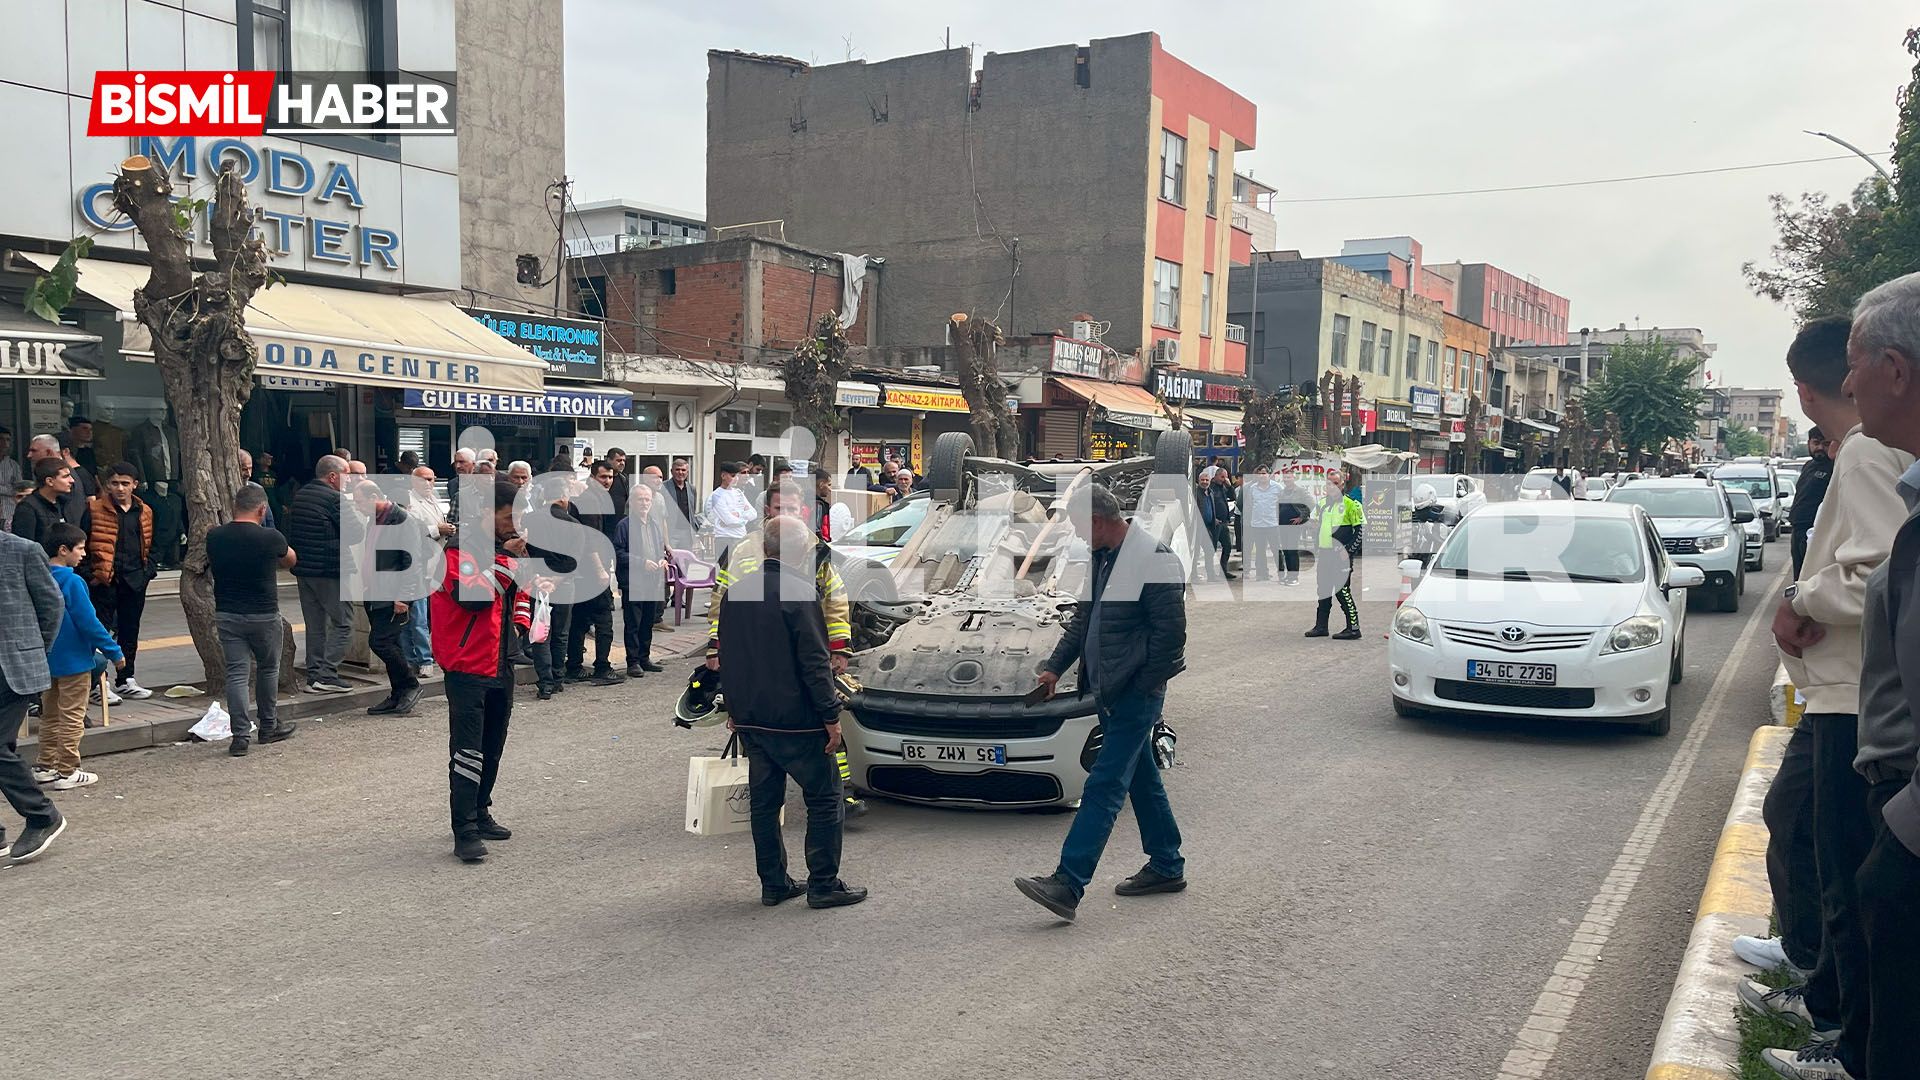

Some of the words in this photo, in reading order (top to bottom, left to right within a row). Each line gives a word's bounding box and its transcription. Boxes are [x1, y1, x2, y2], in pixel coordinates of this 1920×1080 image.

[137, 136, 366, 208] MODA
[79, 181, 400, 270] CTER
[520, 322, 600, 347] ELEKTRONİK
[265, 343, 338, 370] ODA
[358, 352, 480, 384] CENTER
[1084, 346, 1102, 364] GOLD
[268, 376, 332, 387] CENTER
[498, 394, 616, 416] ELEKTRONİK
[1476, 663, 1491, 677] 34
[1498, 664, 1514, 678] GC
[1519, 666, 1553, 681] 2736
[906, 745, 926, 759] 38
[937, 746, 966, 761] KMZ
[976, 747, 996, 761] 35
